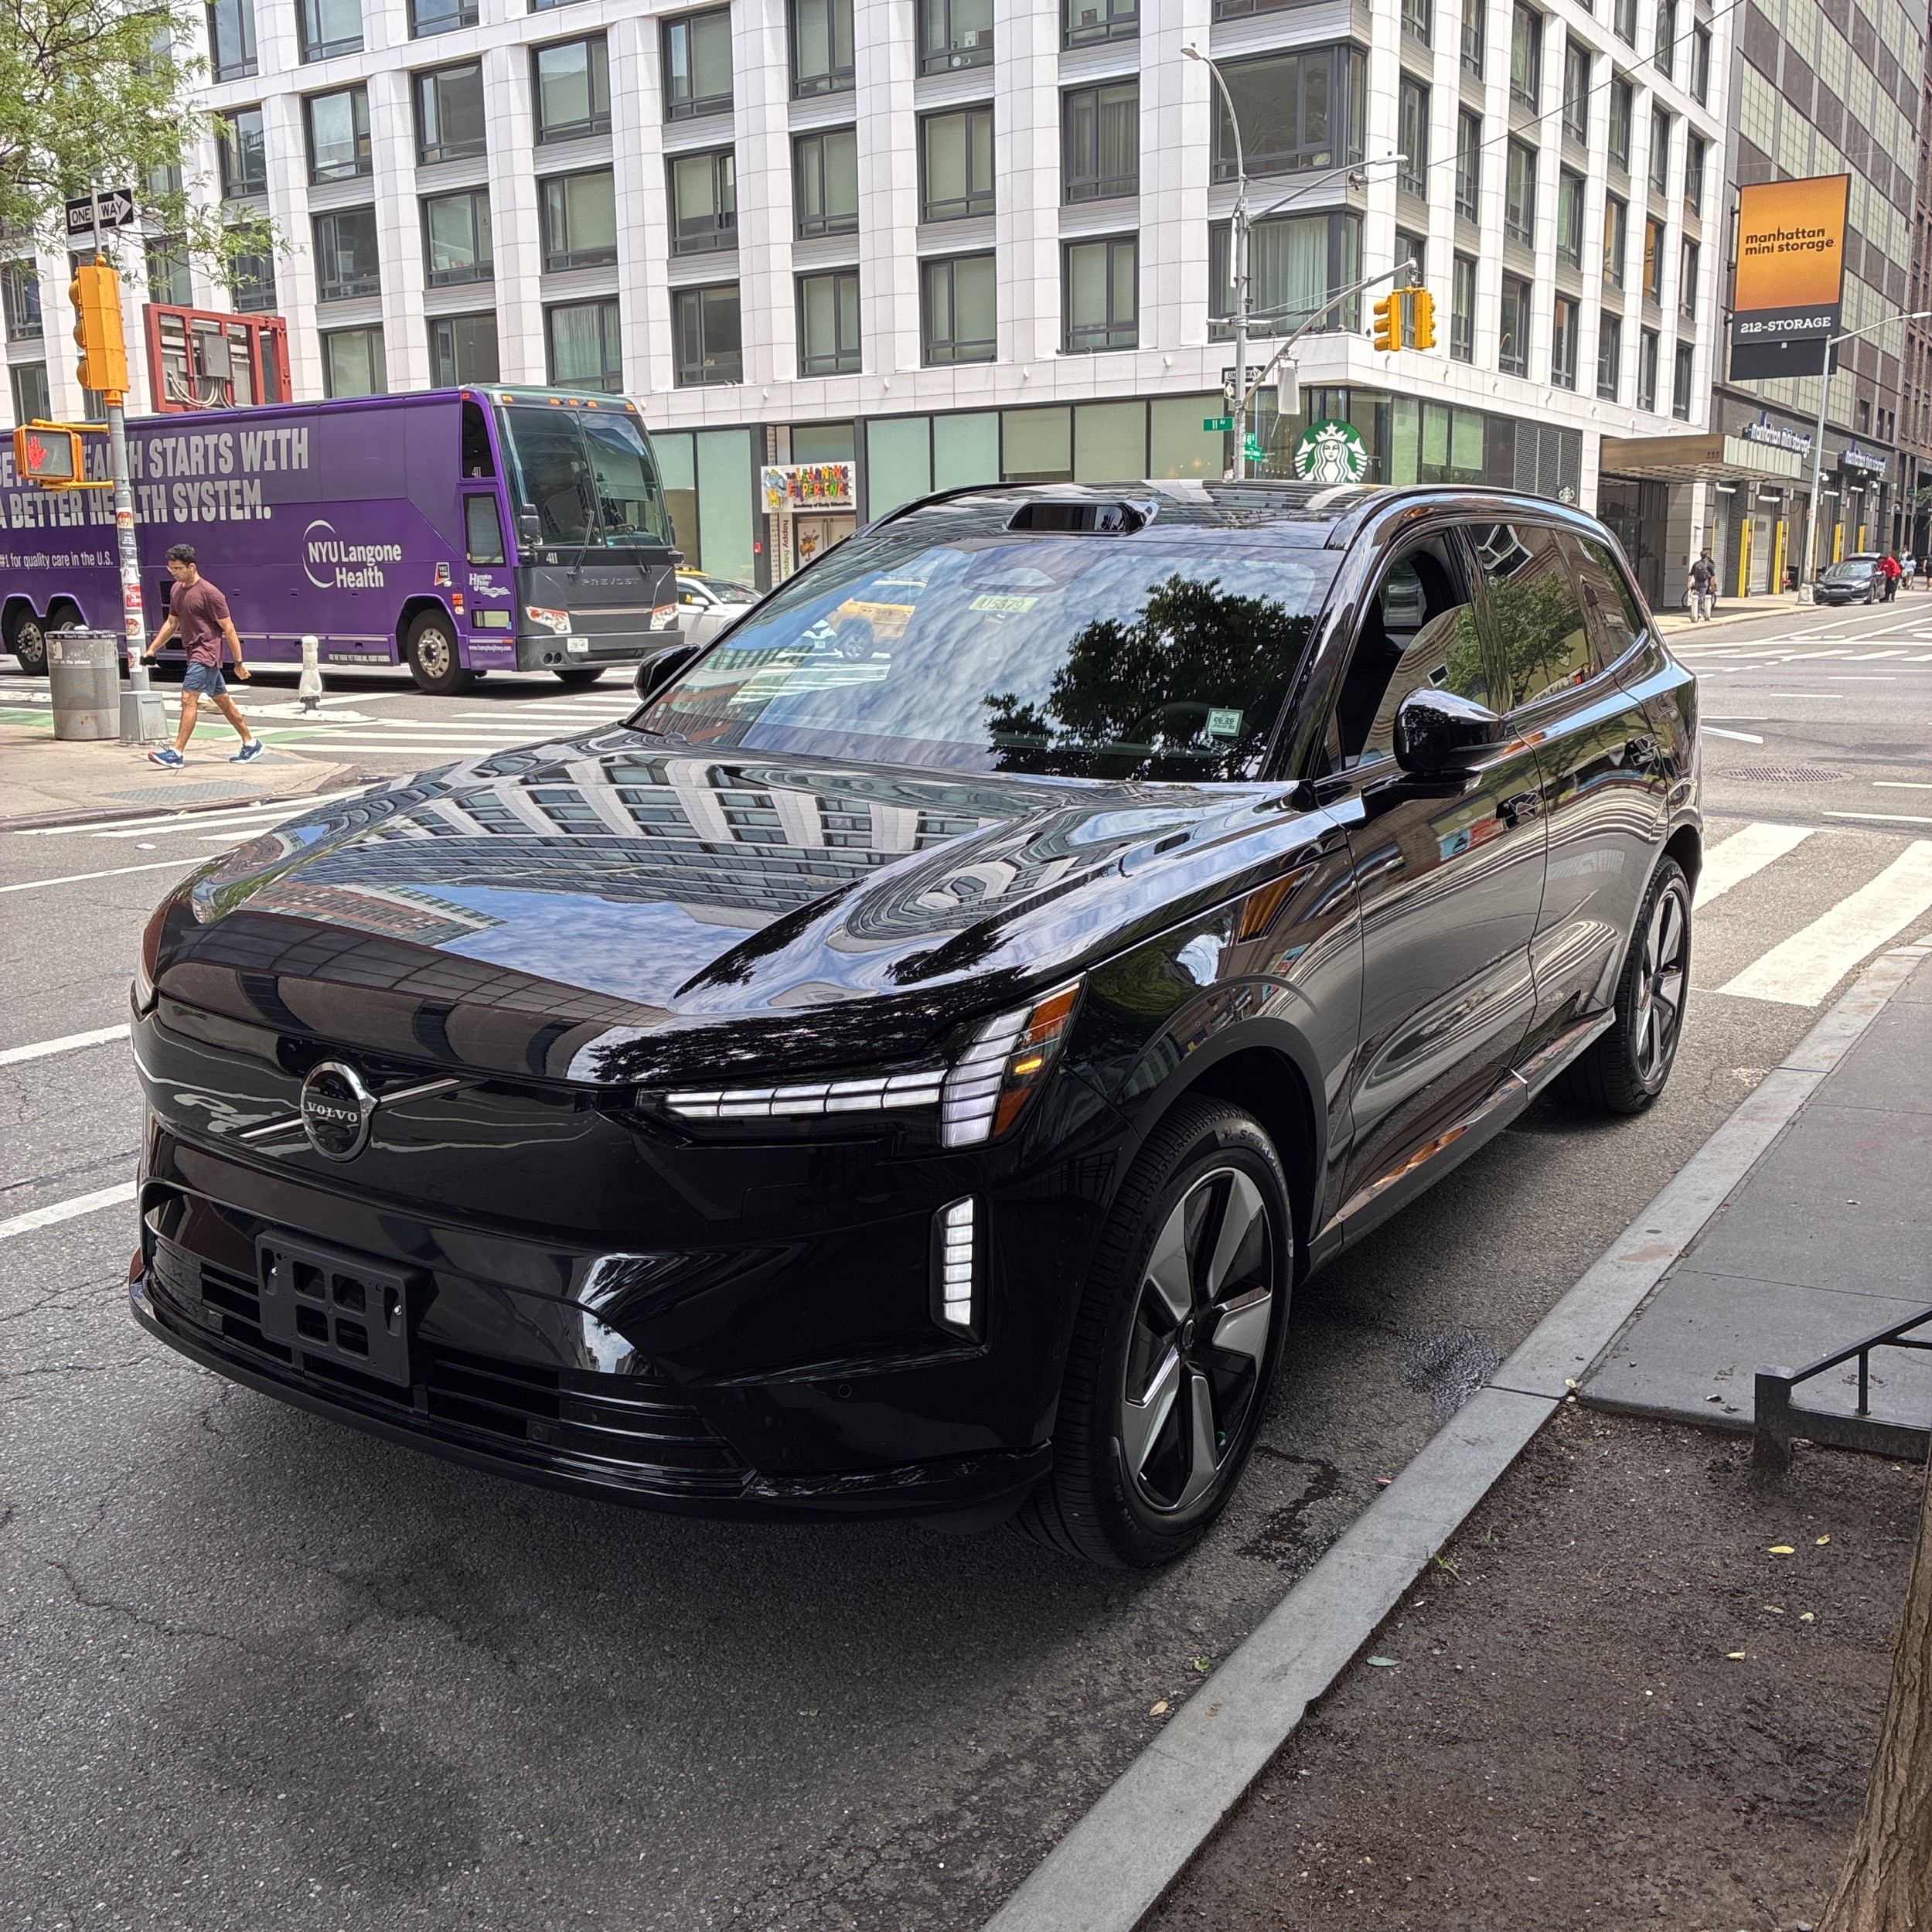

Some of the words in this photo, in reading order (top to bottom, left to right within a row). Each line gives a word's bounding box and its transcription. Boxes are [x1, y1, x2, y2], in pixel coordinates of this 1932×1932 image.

[72, 207, 91, 223] ONE
[101, 200, 123, 217] WAY
[1746, 225, 1825, 244] manhattan
[1745, 243, 1774, 255] mini
[1777, 237, 1835, 252] storage
[1740, 316, 1831, 333] 212-STORAGE
[1211, 420, 1218, 430] 11
[149, 432, 233, 478] STARTS
[240, 427, 308, 472] WITH
[472, 466, 482, 478] 411
[9, 489, 84, 529] BETTER
[89, 483, 168, 526] HELTH
[172, 479, 271, 523] SYSTEM.
[10, 553, 22, 567] for
[23, 551, 50, 571] quality
[52, 554, 70, 567] care
[71, 550, 80, 565] in
[80, 550, 95, 565] the
[97, 550, 114, 566] U.S.
[308, 541, 339, 563] NYU
[339, 540, 402, 566] Langone
[546, 552, 558, 564] 411
[336, 566, 384, 588] Health
[978, 598, 1026, 611] U5379
[306, 1101, 358, 1123] VOLVO
